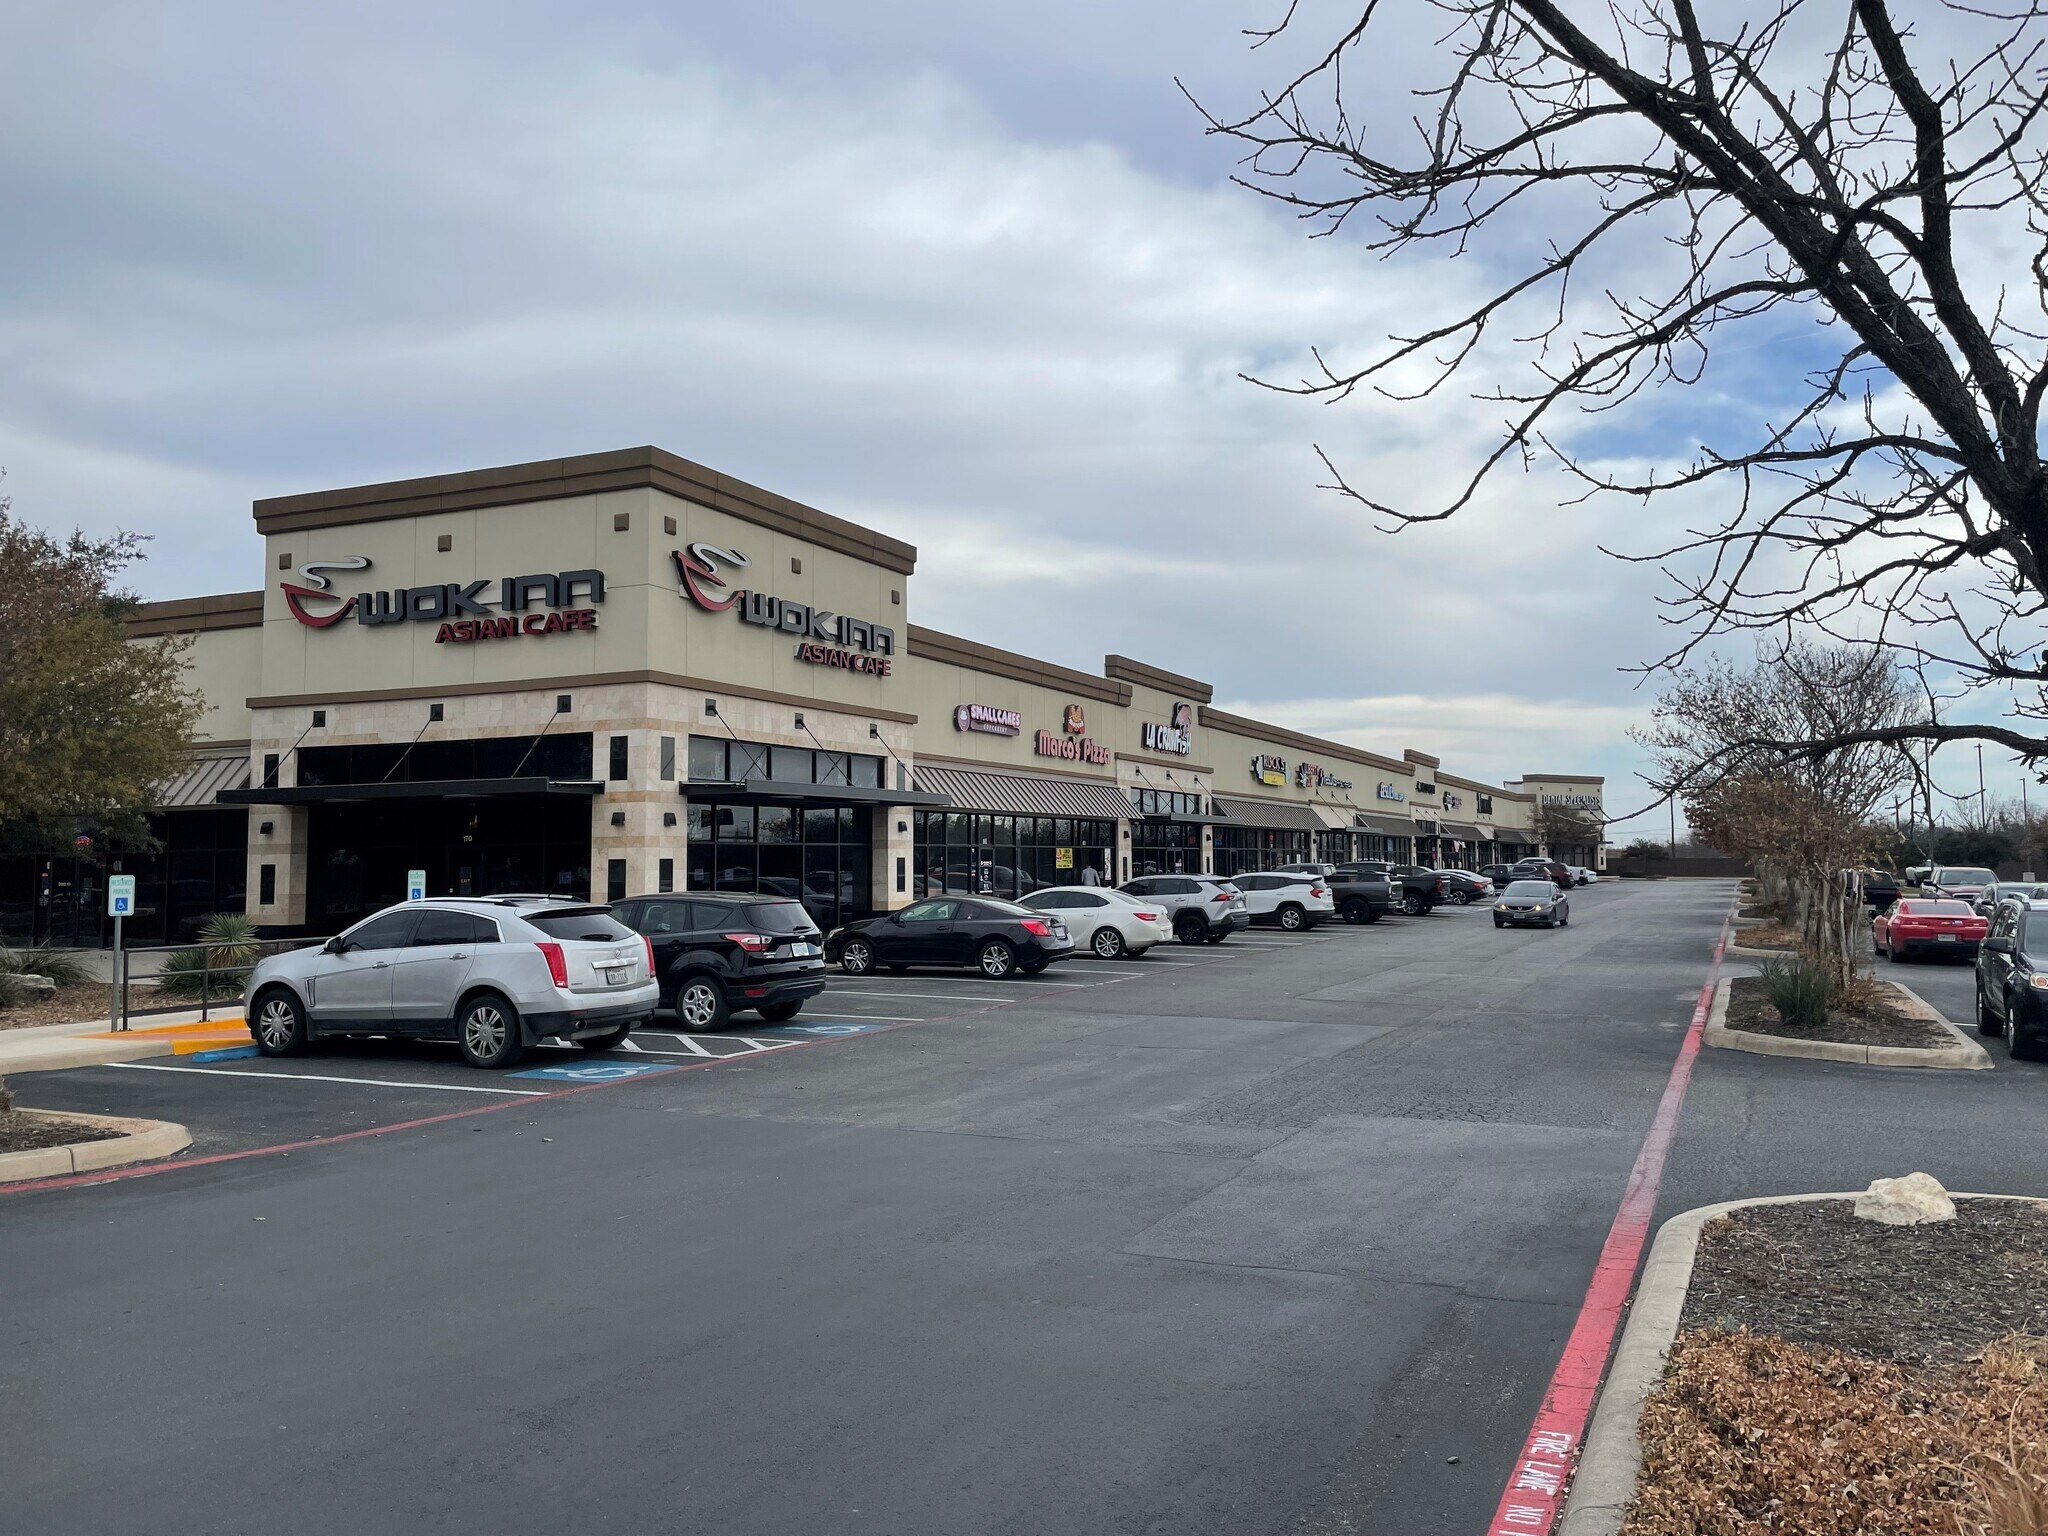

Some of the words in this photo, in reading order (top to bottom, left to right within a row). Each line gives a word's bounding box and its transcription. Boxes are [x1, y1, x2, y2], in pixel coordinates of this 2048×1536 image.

[358, 579, 493, 625] WOK
[743, 590, 836, 641] WOK
[435, 616, 519, 644] ASIAN
[522, 609, 598, 635] CAFE
[800, 643, 850, 668] ASIAN
[852, 653, 892, 677] CAFE
[970, 704, 1021, 727] SMALLCAKES
[1036, 729, 1081, 760] Marco's
[1081, 738, 1111, 765] Pizza
[1144, 722, 1156, 748] LA
[1542, 794, 1565, 805] DENTAL
[1531, 1430, 1573, 1458] FIRE
[1517, 1460, 1564, 1496] LANE
[1504, 1504, 1545, 1525] NO
